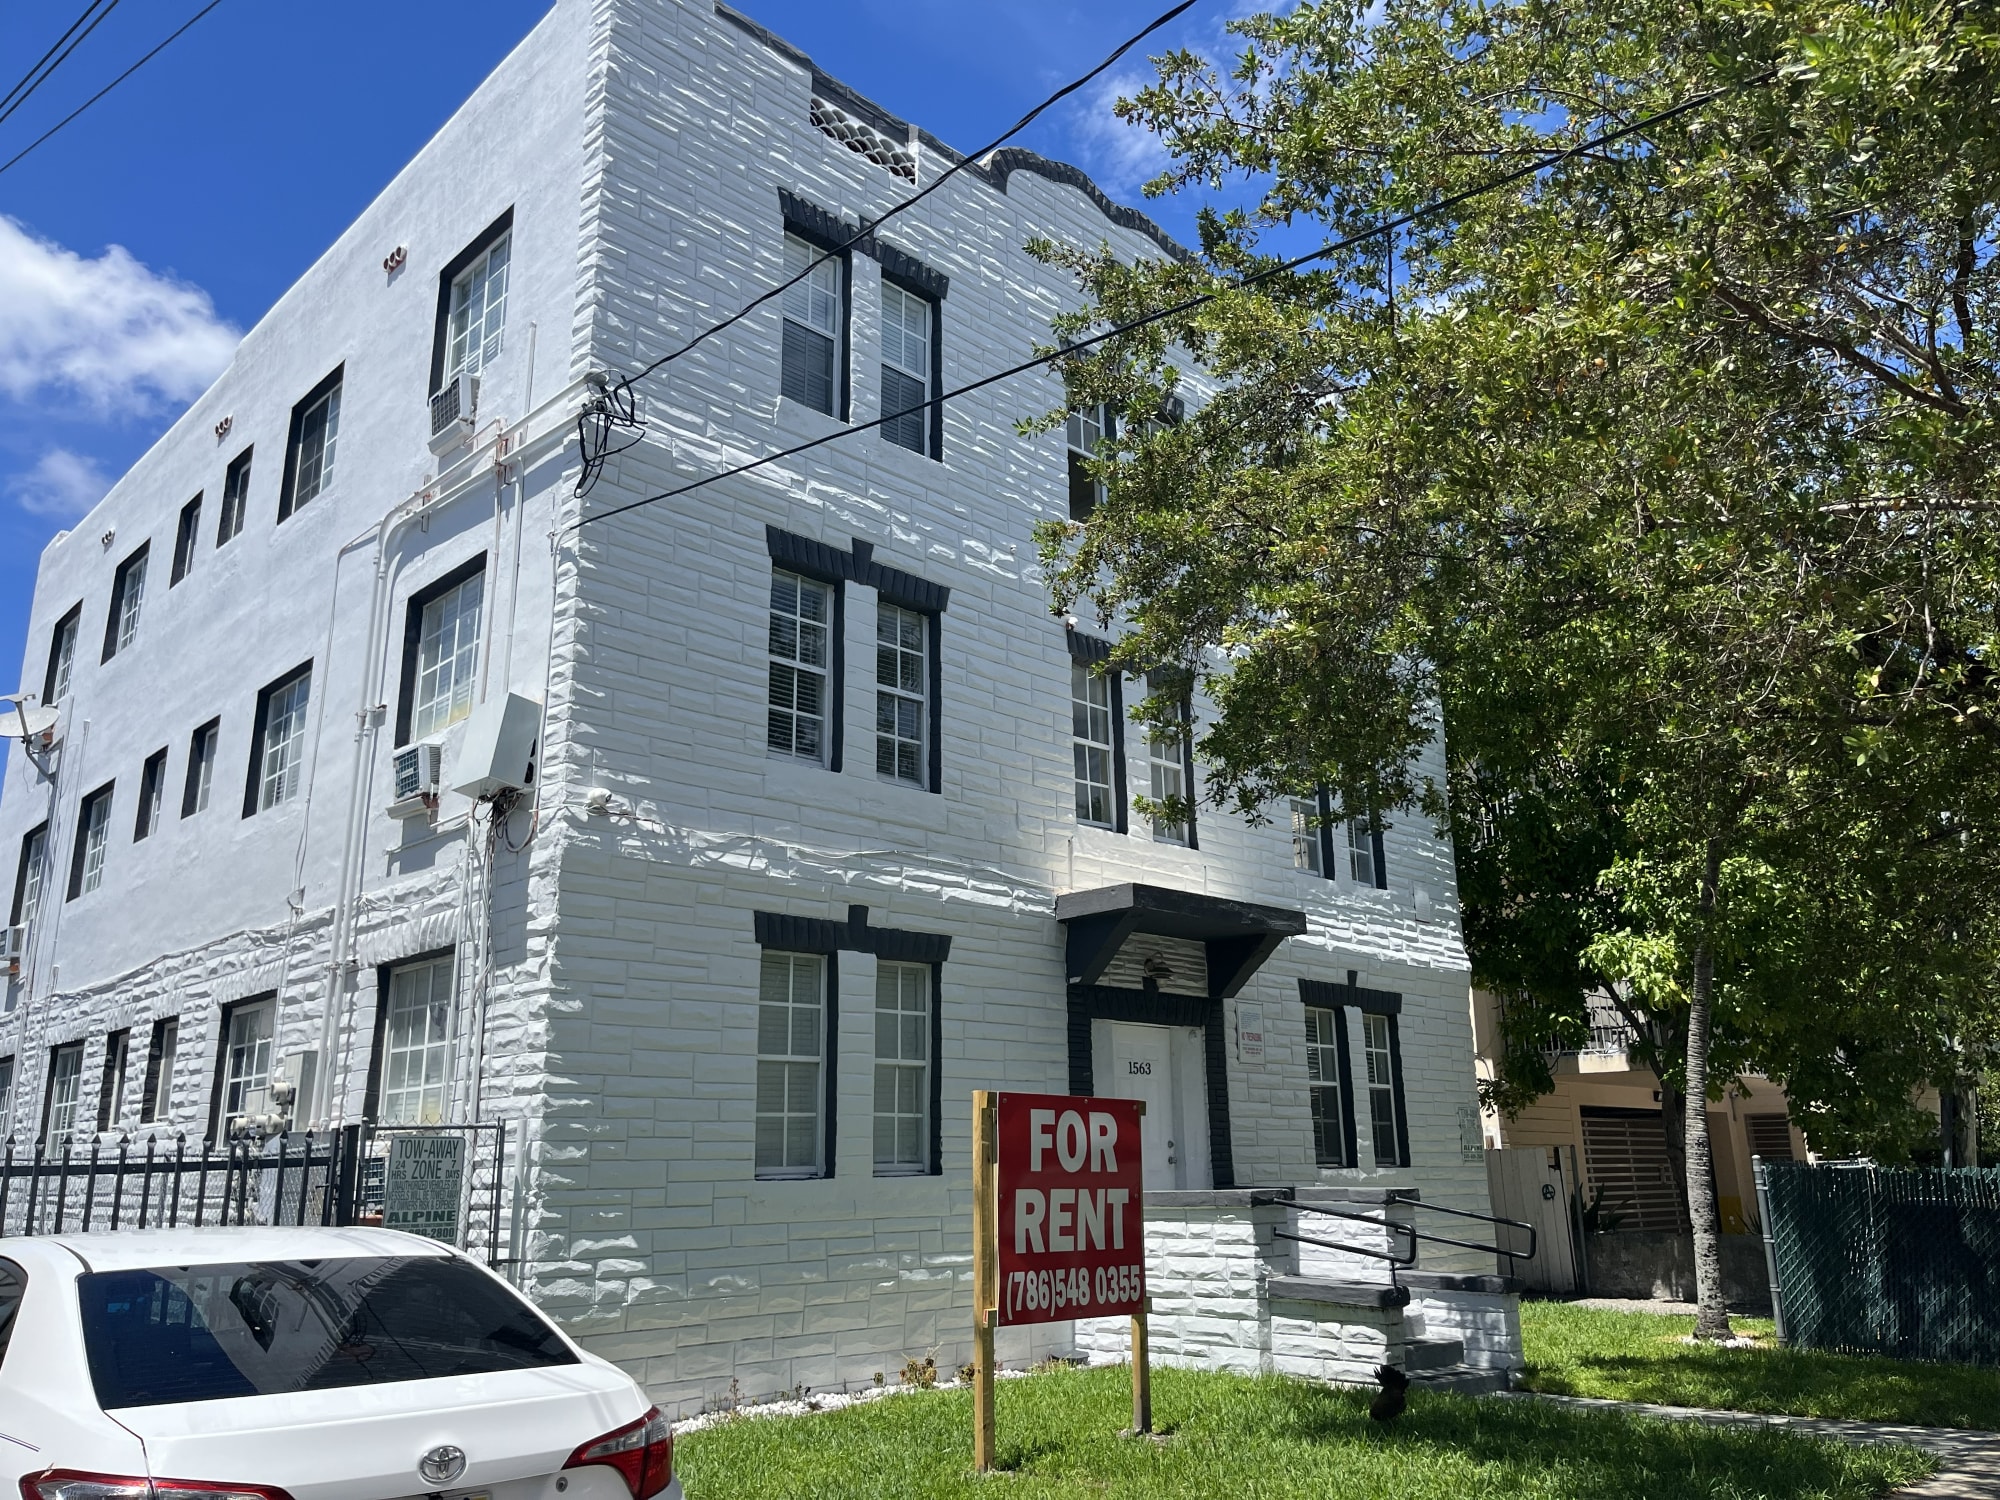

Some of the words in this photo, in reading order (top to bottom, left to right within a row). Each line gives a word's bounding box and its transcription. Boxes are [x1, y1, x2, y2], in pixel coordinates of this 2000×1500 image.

[1128, 1061, 1151, 1075] 1563
[1030, 1108, 1118, 1173] FOR
[399, 1140, 459, 1159] TOW-AWAY
[395, 1160, 406, 1169] 24
[411, 1160, 442, 1179] ZONE
[451, 1160, 457, 1168] 7
[391, 1170, 407, 1179] HRS
[445, 1170, 460, 1179] DAYS
[387, 1210, 456, 1223] ALPINE
[1015, 1188, 1129, 1254] RENT
[1006, 1267, 1090, 1320] (786)548
[1095, 1265, 1141, 1304] 0355
